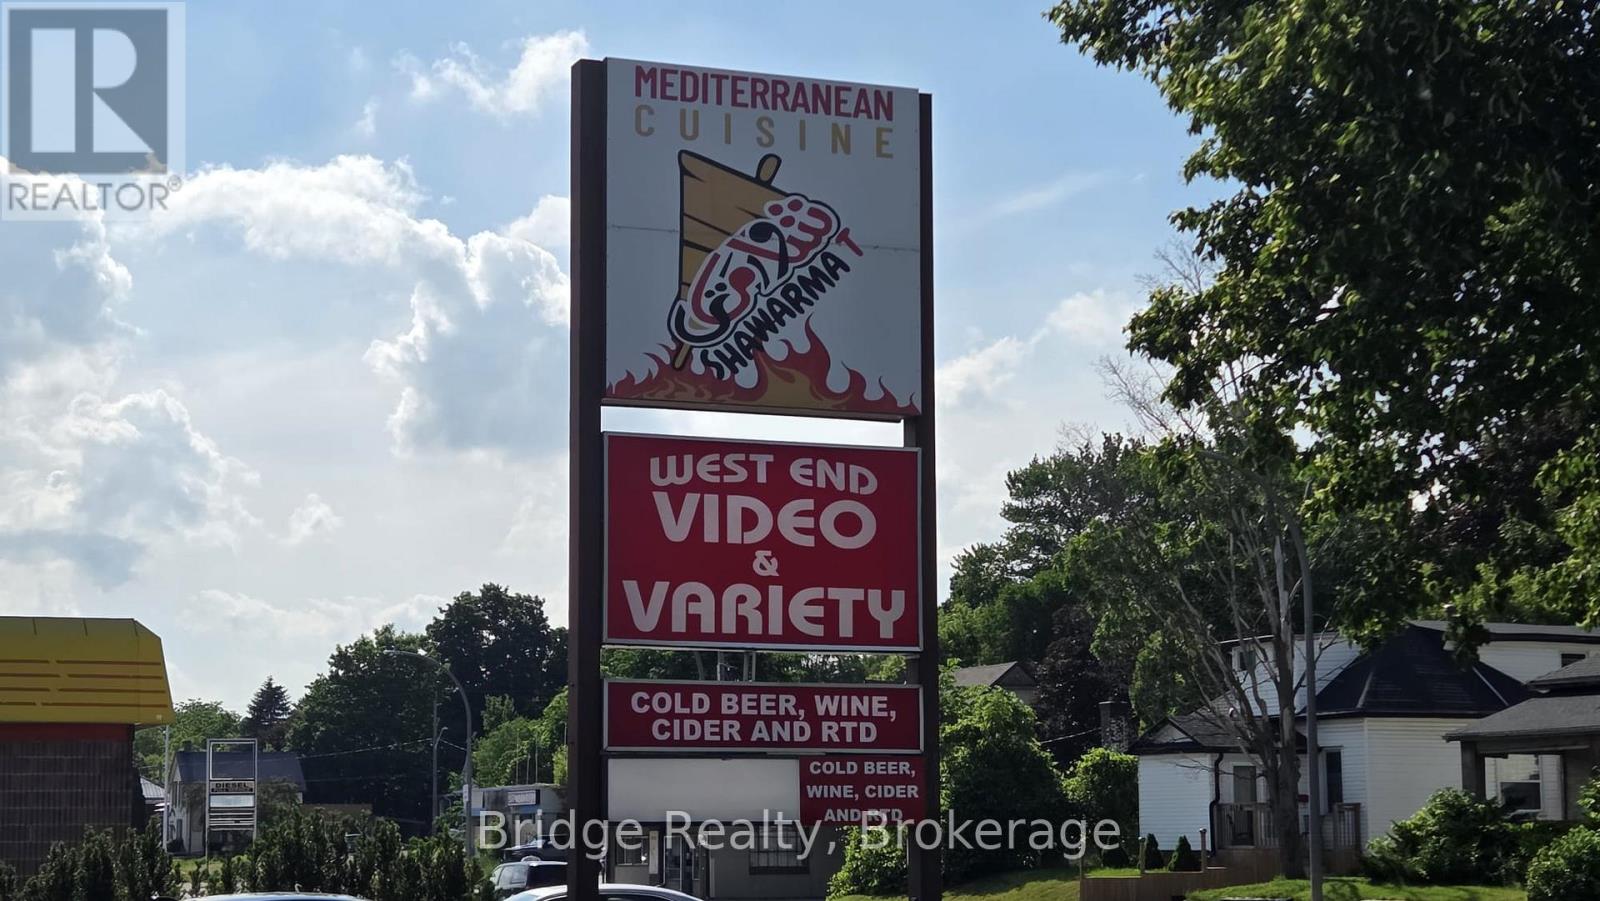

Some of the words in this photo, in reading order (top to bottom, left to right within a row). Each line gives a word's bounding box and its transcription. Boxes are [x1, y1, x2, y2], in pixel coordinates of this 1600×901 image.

[634, 65, 894, 122] MEDITERRANEAN
[634, 104, 894, 159] CUISINE
[700, 251, 851, 380] SHAWARMA
[650, 453, 774, 487] WEST
[789, 457, 878, 496] END
[652, 491, 877, 550] VIDEO
[752, 550, 780, 577] &
[622, 580, 906, 639] VARIETY
[631, 692, 711, 715] COLD
[720, 693, 806, 720] BEER,
[814, 695, 897, 722] WINE,
[651, 719, 742, 742] CIDER
[750, 720, 811, 743] AND
[821, 721, 878, 743] RTD
[809, 761, 858, 775] COLD
[863, 761, 916, 778] BEER,
[806, 785, 859, 801] WINE,
[864, 785, 919, 799] CIDER
[824, 808, 862, 822] AND
